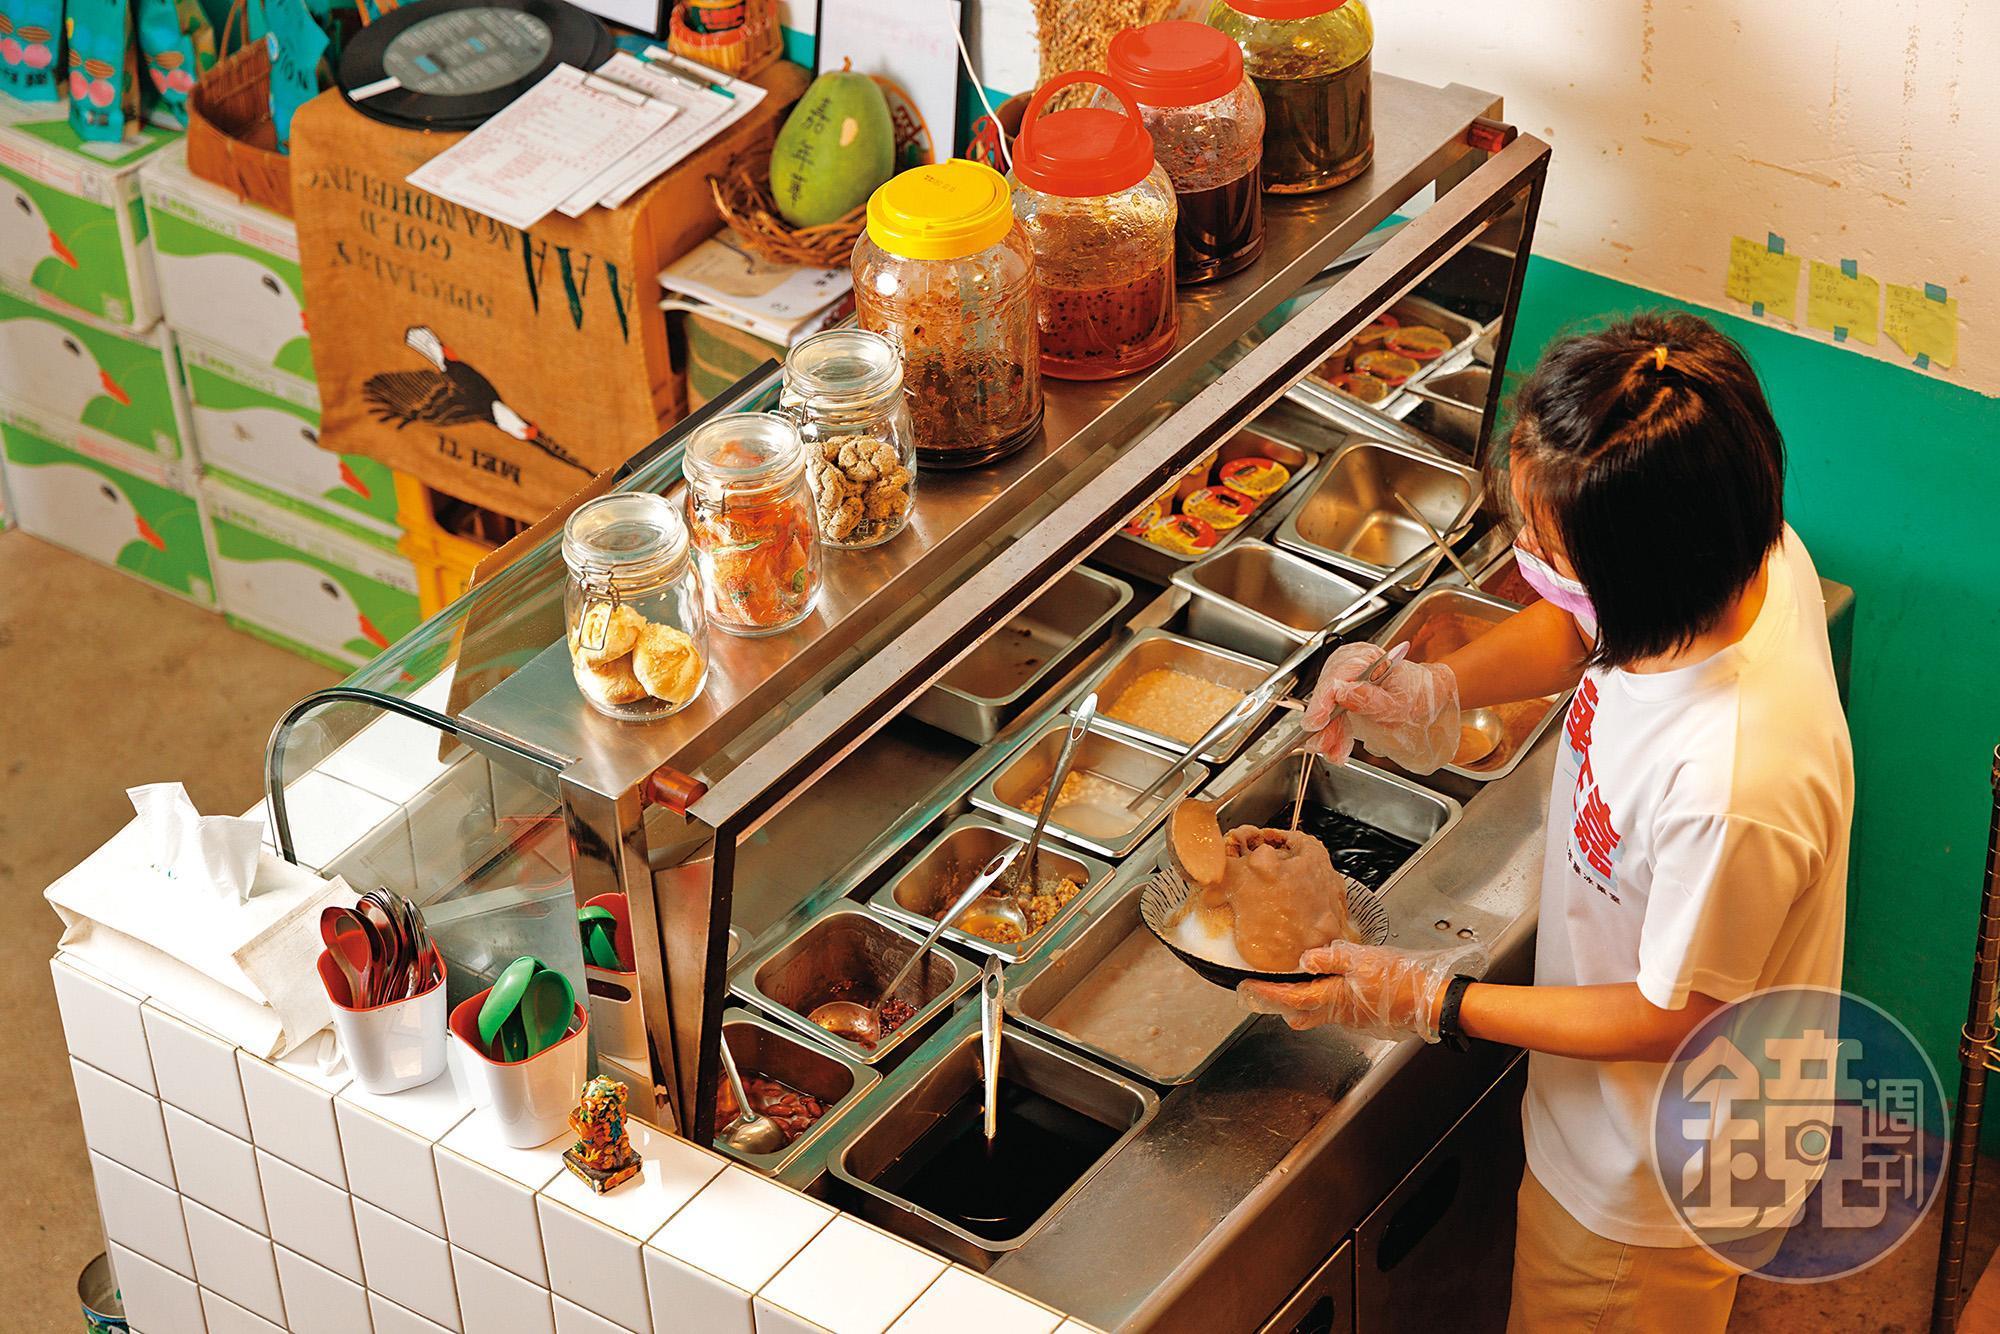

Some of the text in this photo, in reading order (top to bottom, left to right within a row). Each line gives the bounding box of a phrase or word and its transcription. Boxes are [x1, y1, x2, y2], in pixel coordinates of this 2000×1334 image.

[360, 208, 452, 262] GOLD
[330, 240, 494, 319] SPECIALTY
[438, 433, 522, 486] MEI TI
